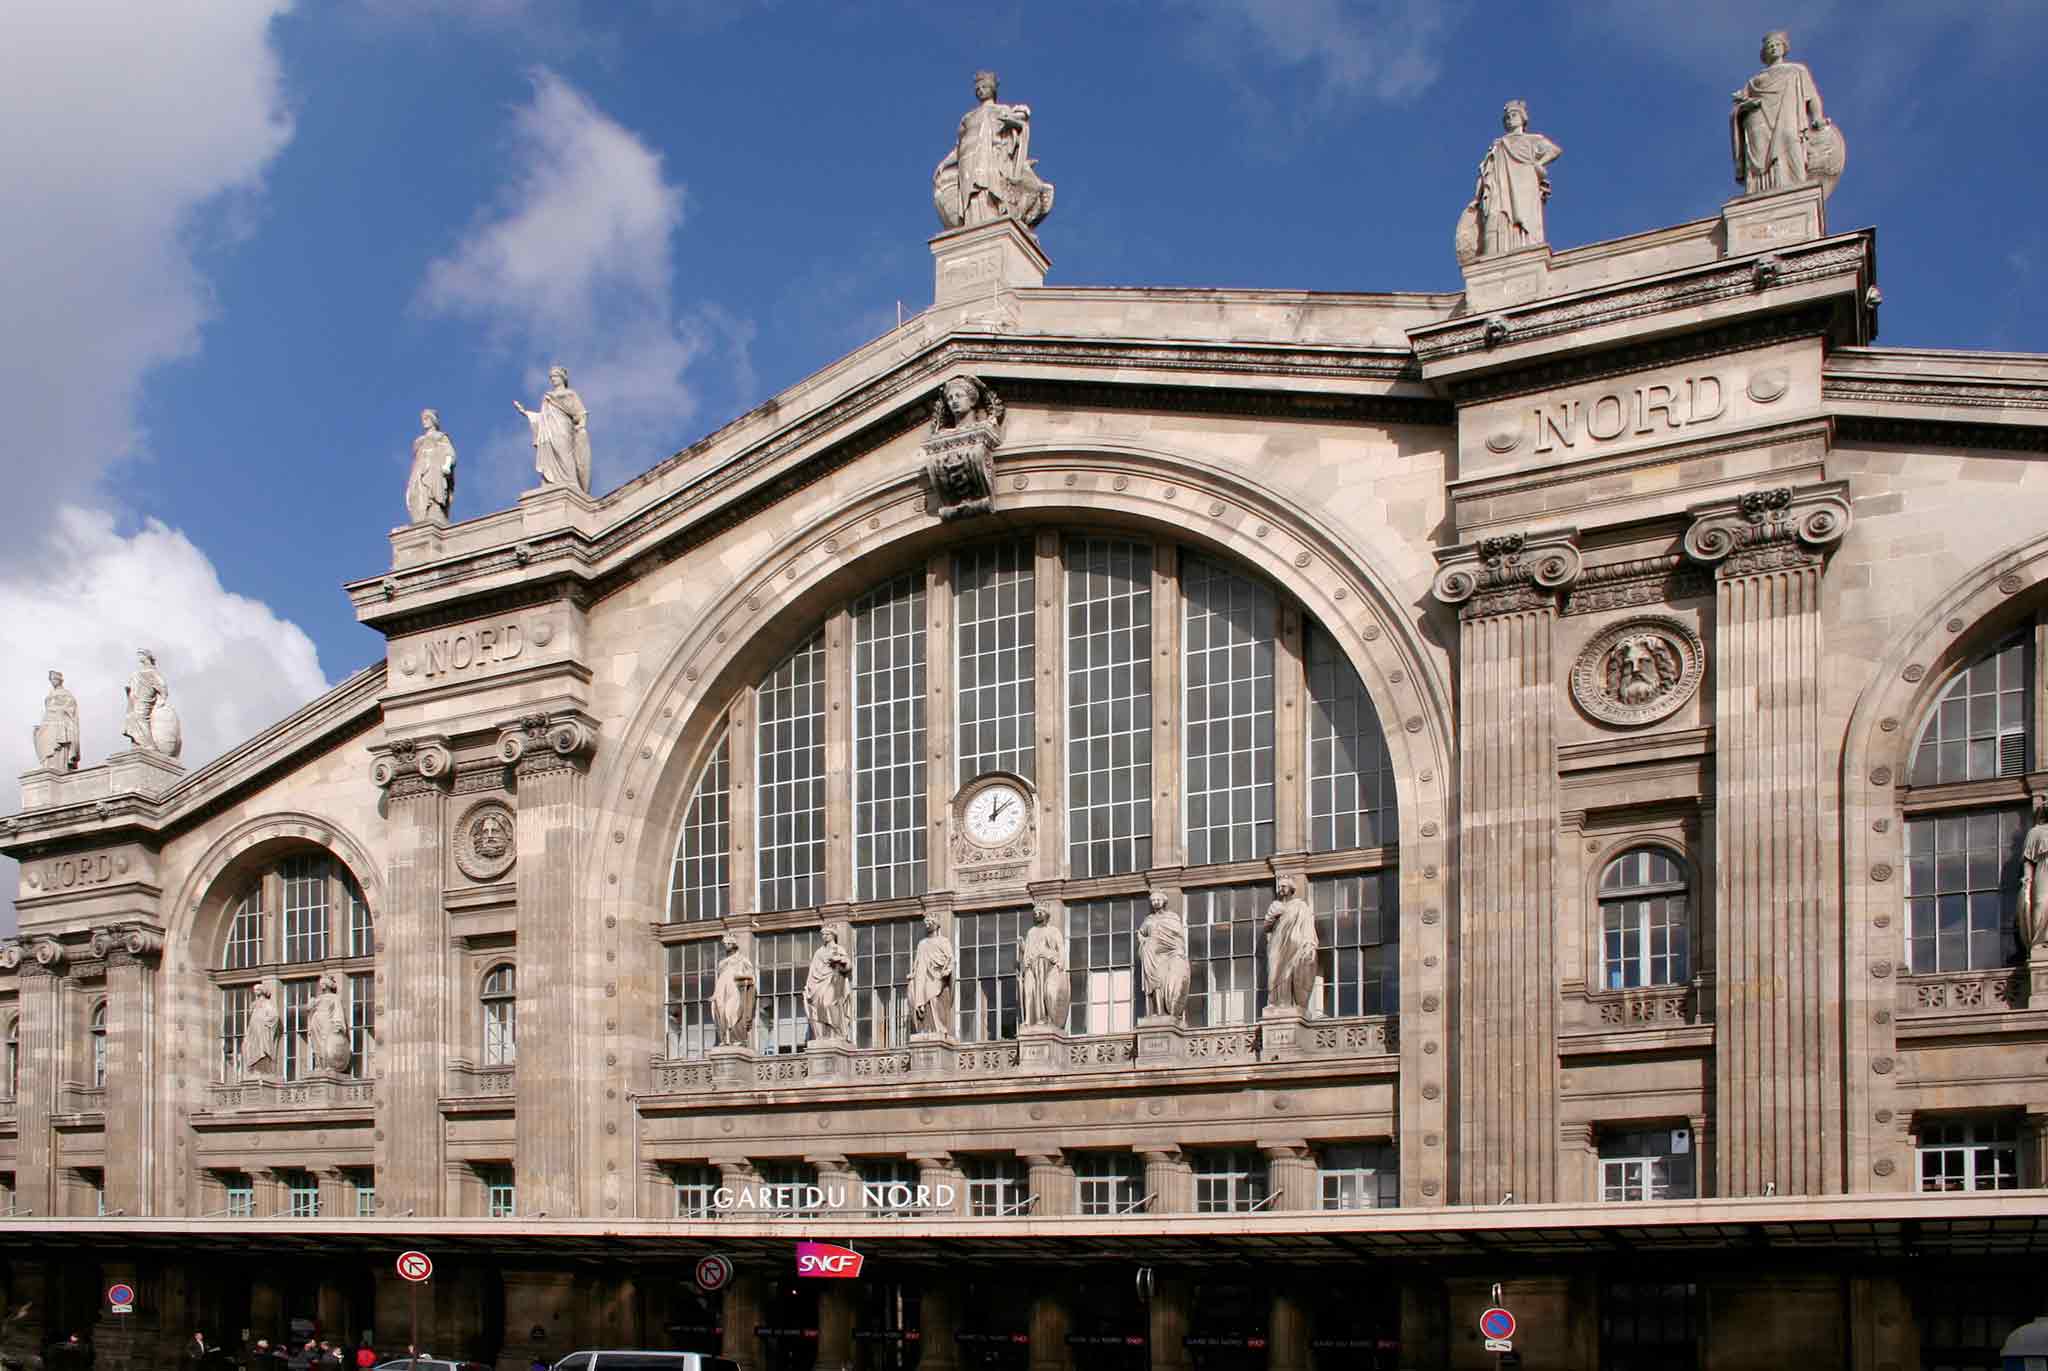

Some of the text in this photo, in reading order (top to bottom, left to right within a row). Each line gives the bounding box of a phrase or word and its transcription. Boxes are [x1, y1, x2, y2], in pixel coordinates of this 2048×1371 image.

[1533, 375, 1727, 453] NORD
[424, 625, 524, 677] NORD
[38, 855, 112, 891] NORD
[713, 1184, 955, 1208] GARE DU NORD
[800, 1255, 857, 1272] SNCF
